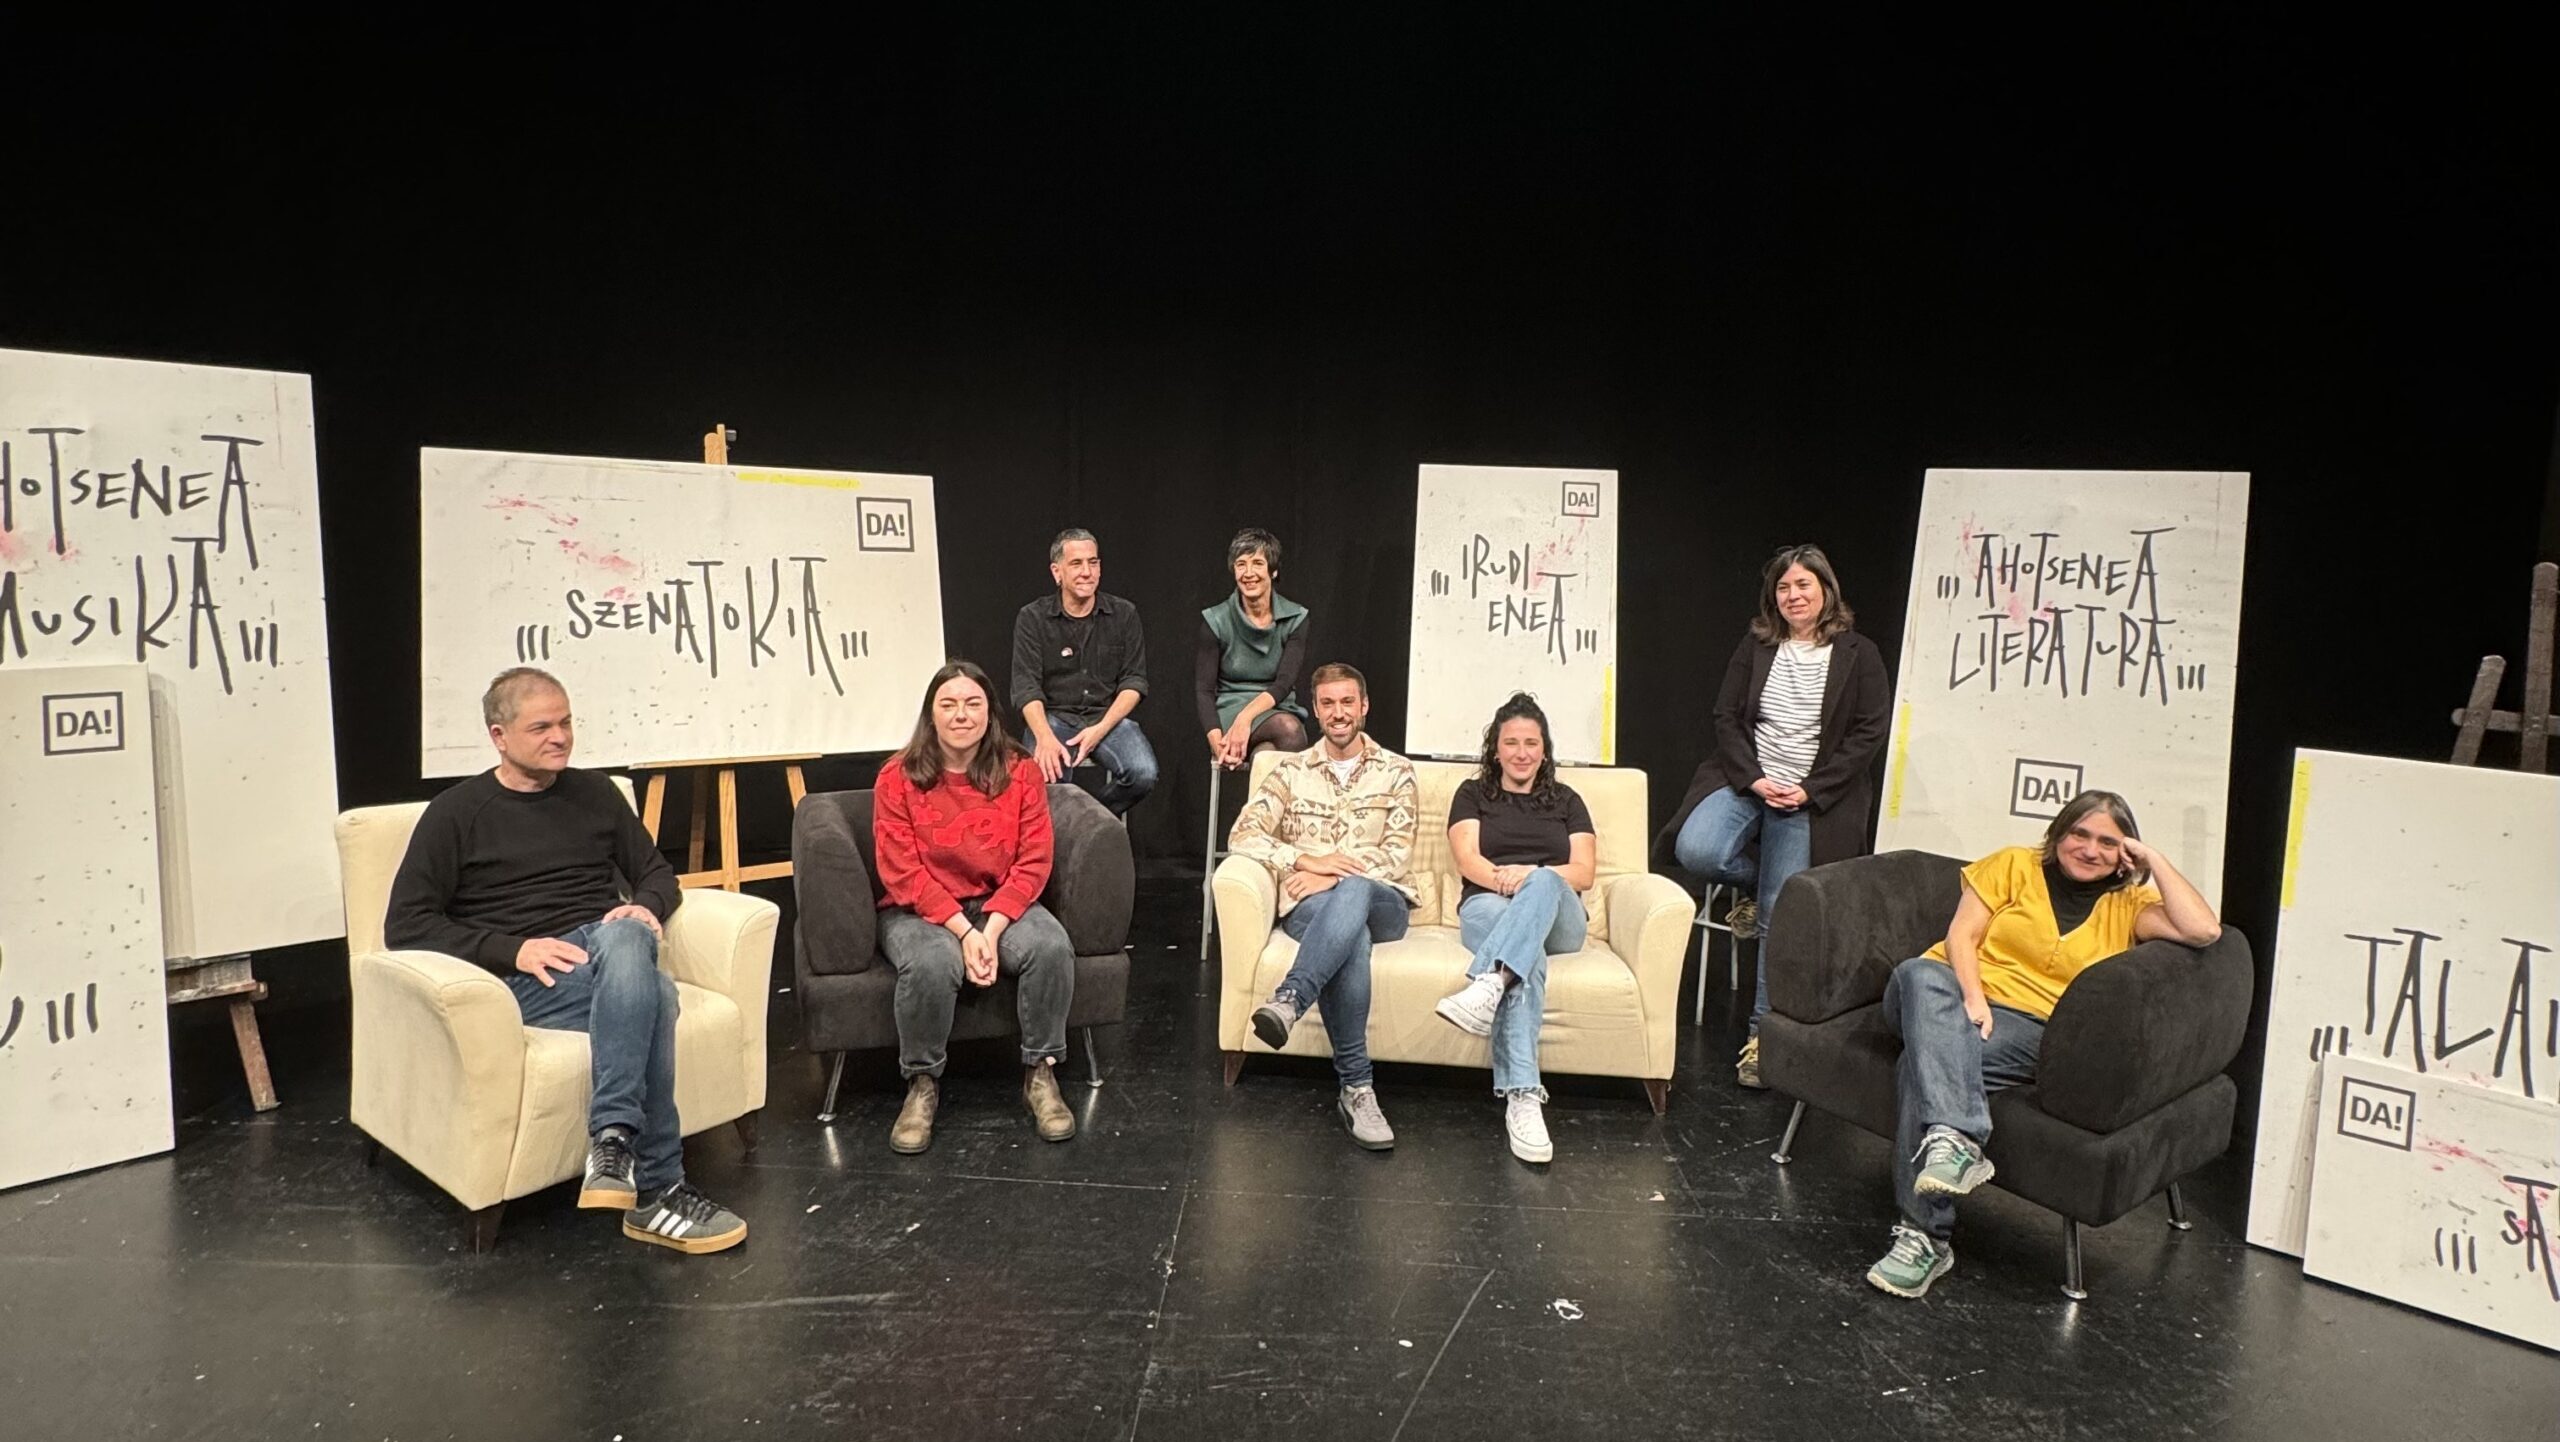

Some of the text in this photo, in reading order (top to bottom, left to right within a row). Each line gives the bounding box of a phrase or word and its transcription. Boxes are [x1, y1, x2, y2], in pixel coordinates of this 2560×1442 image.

[865, 511, 906, 537] DA!
[1567, 491, 1595, 507] DA!
[1462, 534, 1530, 599] IRUDI
[1972, 527, 2177, 623] AHOTSENEA
[566, 556, 844, 697] SZENATOKIA
[1488, 571, 1578, 665] ENEA
[1949, 604, 2176, 706] LITERATURA
[56, 709, 113, 738] DA!
[2022, 776, 2071, 805] DA!
[2344, 928, 2560, 1104] TALAI
[2350, 1096, 2403, 1132] DA!
[2501, 1175, 2560, 1302] SA
